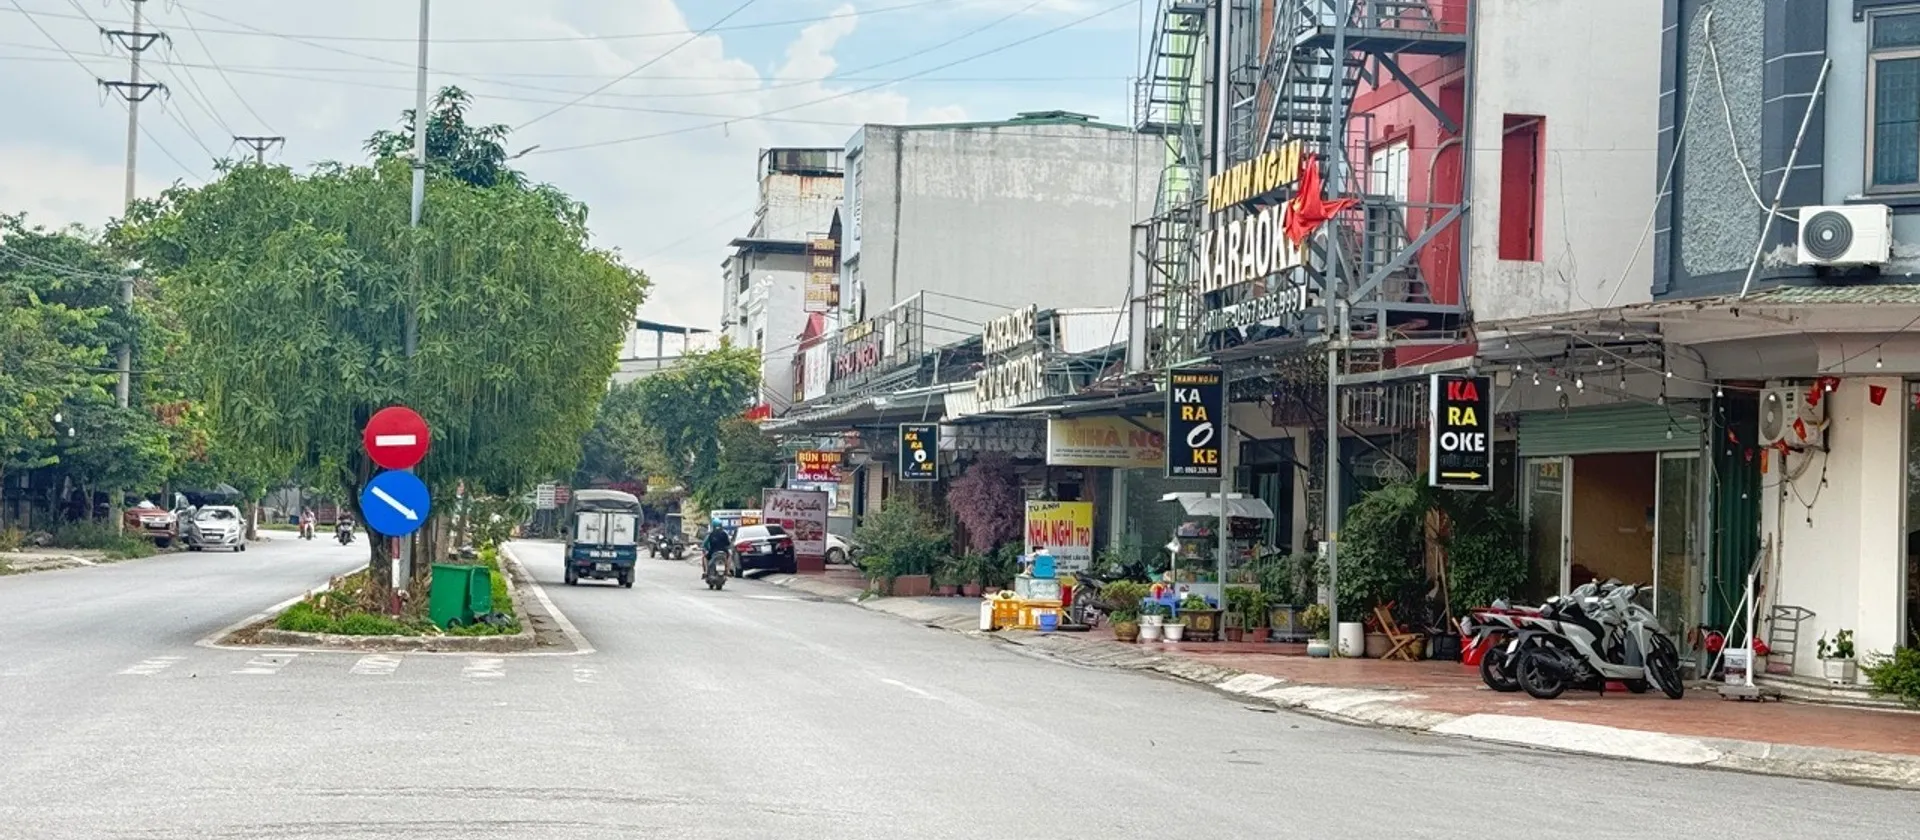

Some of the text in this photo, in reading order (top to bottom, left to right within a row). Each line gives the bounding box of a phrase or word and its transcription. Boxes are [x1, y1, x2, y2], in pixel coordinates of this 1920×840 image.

[1207, 131, 1303, 215] THANH NGÂN
[982, 303, 1036, 356] KARAOKE
[1173, 374, 1197, 384] THANH
[1174, 388, 1201, 403] KA
[1447, 381, 1479, 401] KA
[1182, 405, 1208, 420] RA
[1448, 406, 1478, 426] RA
[904, 432, 918, 441] KA
[1186, 421, 1214, 448] O
[1440, 431, 1485, 452] OKE
[911, 441, 923, 449] RA
[914, 449, 927, 463] O
[1193, 449, 1218, 464] KE
[920, 462, 933, 471] KE
